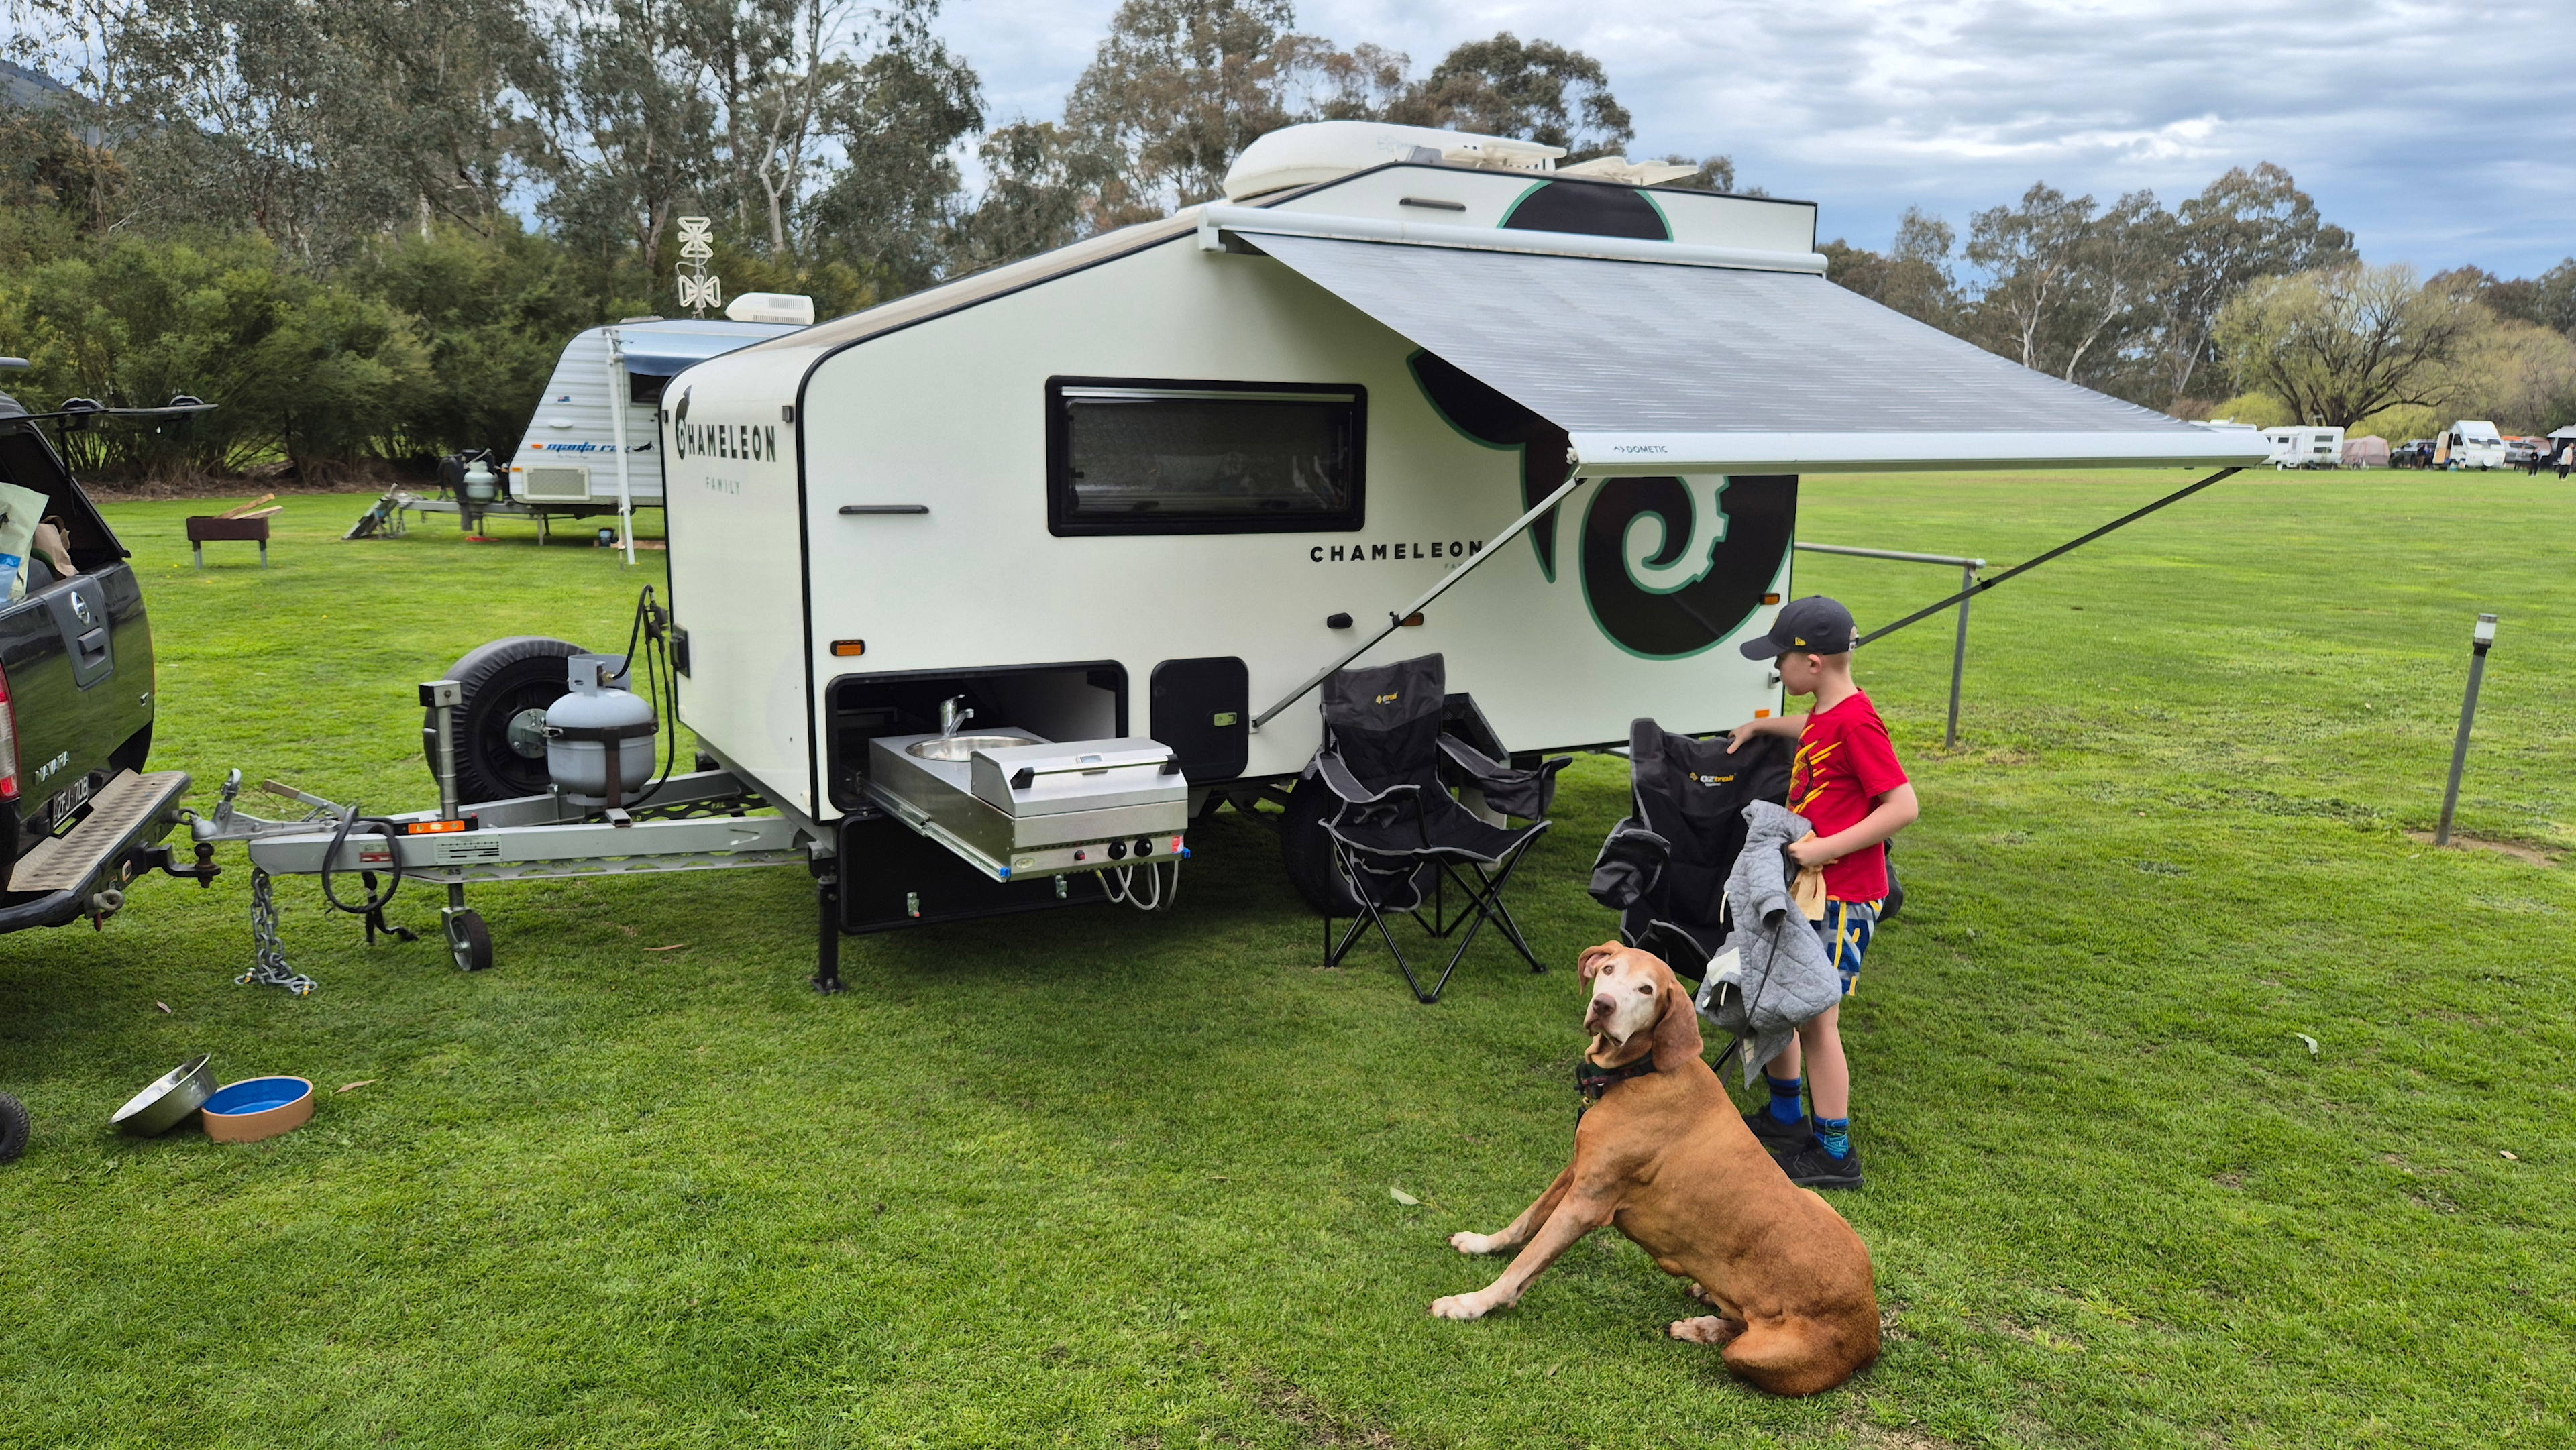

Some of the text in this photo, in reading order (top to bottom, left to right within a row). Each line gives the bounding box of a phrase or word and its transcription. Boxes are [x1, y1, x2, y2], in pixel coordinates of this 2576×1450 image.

[676, 384, 776, 462] CHAMELEON
[547, 441, 596, 453] manta
[1626, 445, 1668, 453] DOMETIC
[706, 476, 740, 494] FAMILY
[1310, 541, 1483, 563] CHAMELEON
